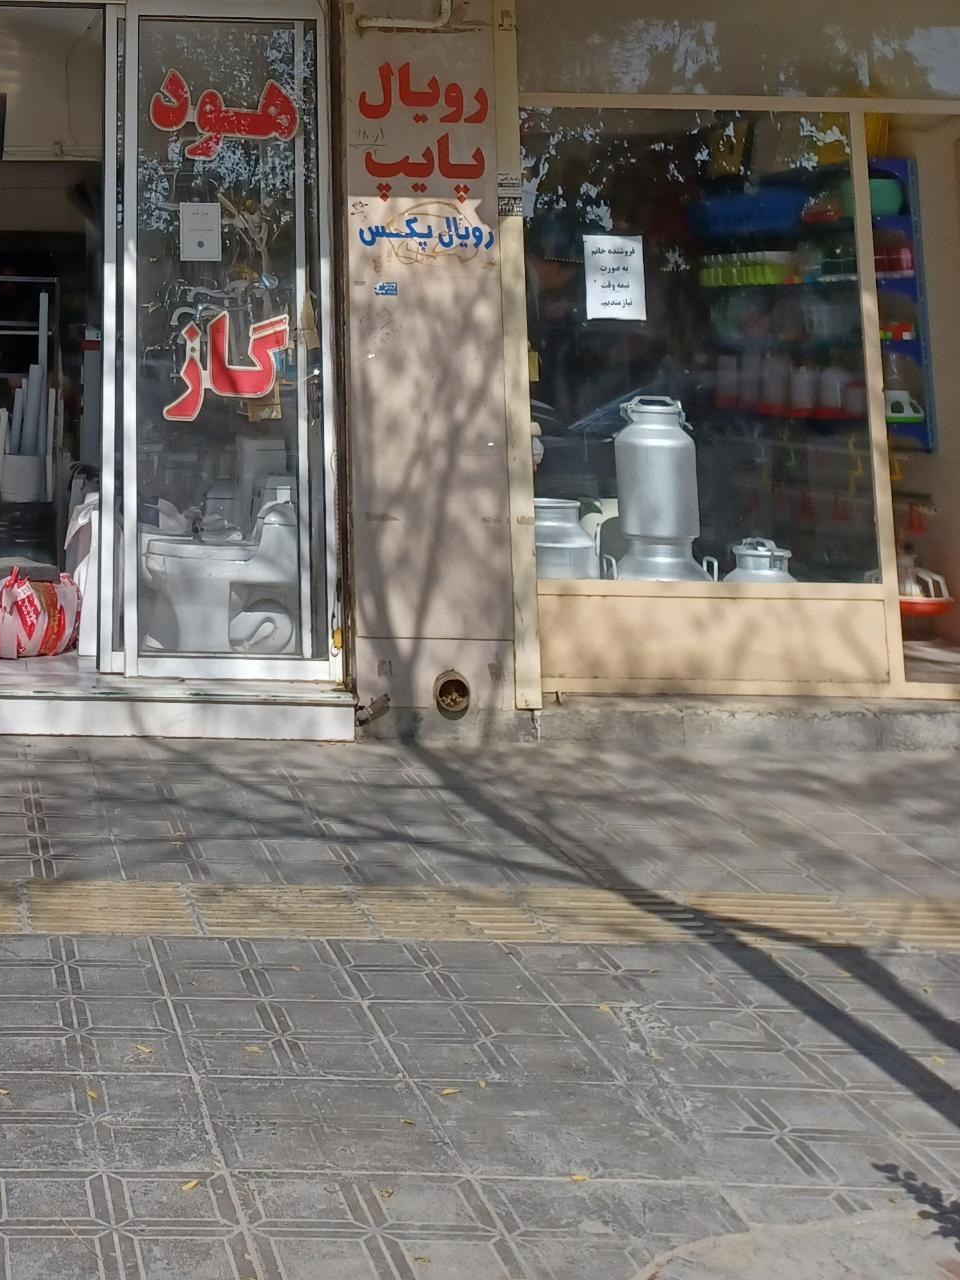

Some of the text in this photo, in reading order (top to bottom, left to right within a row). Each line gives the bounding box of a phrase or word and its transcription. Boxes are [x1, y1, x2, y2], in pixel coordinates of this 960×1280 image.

[150, 68, 299, 160] هود
[358, 62, 490, 124] رویال
[364, 132, 486, 204] پایپ
[358, 217, 495, 253] رویال پکس
[591, 247, 636, 257] فروشنده خانم
[600, 265, 621, 274] صورت
[601, 281, 616, 291] وقت
[163, 311, 289, 421] گاز
